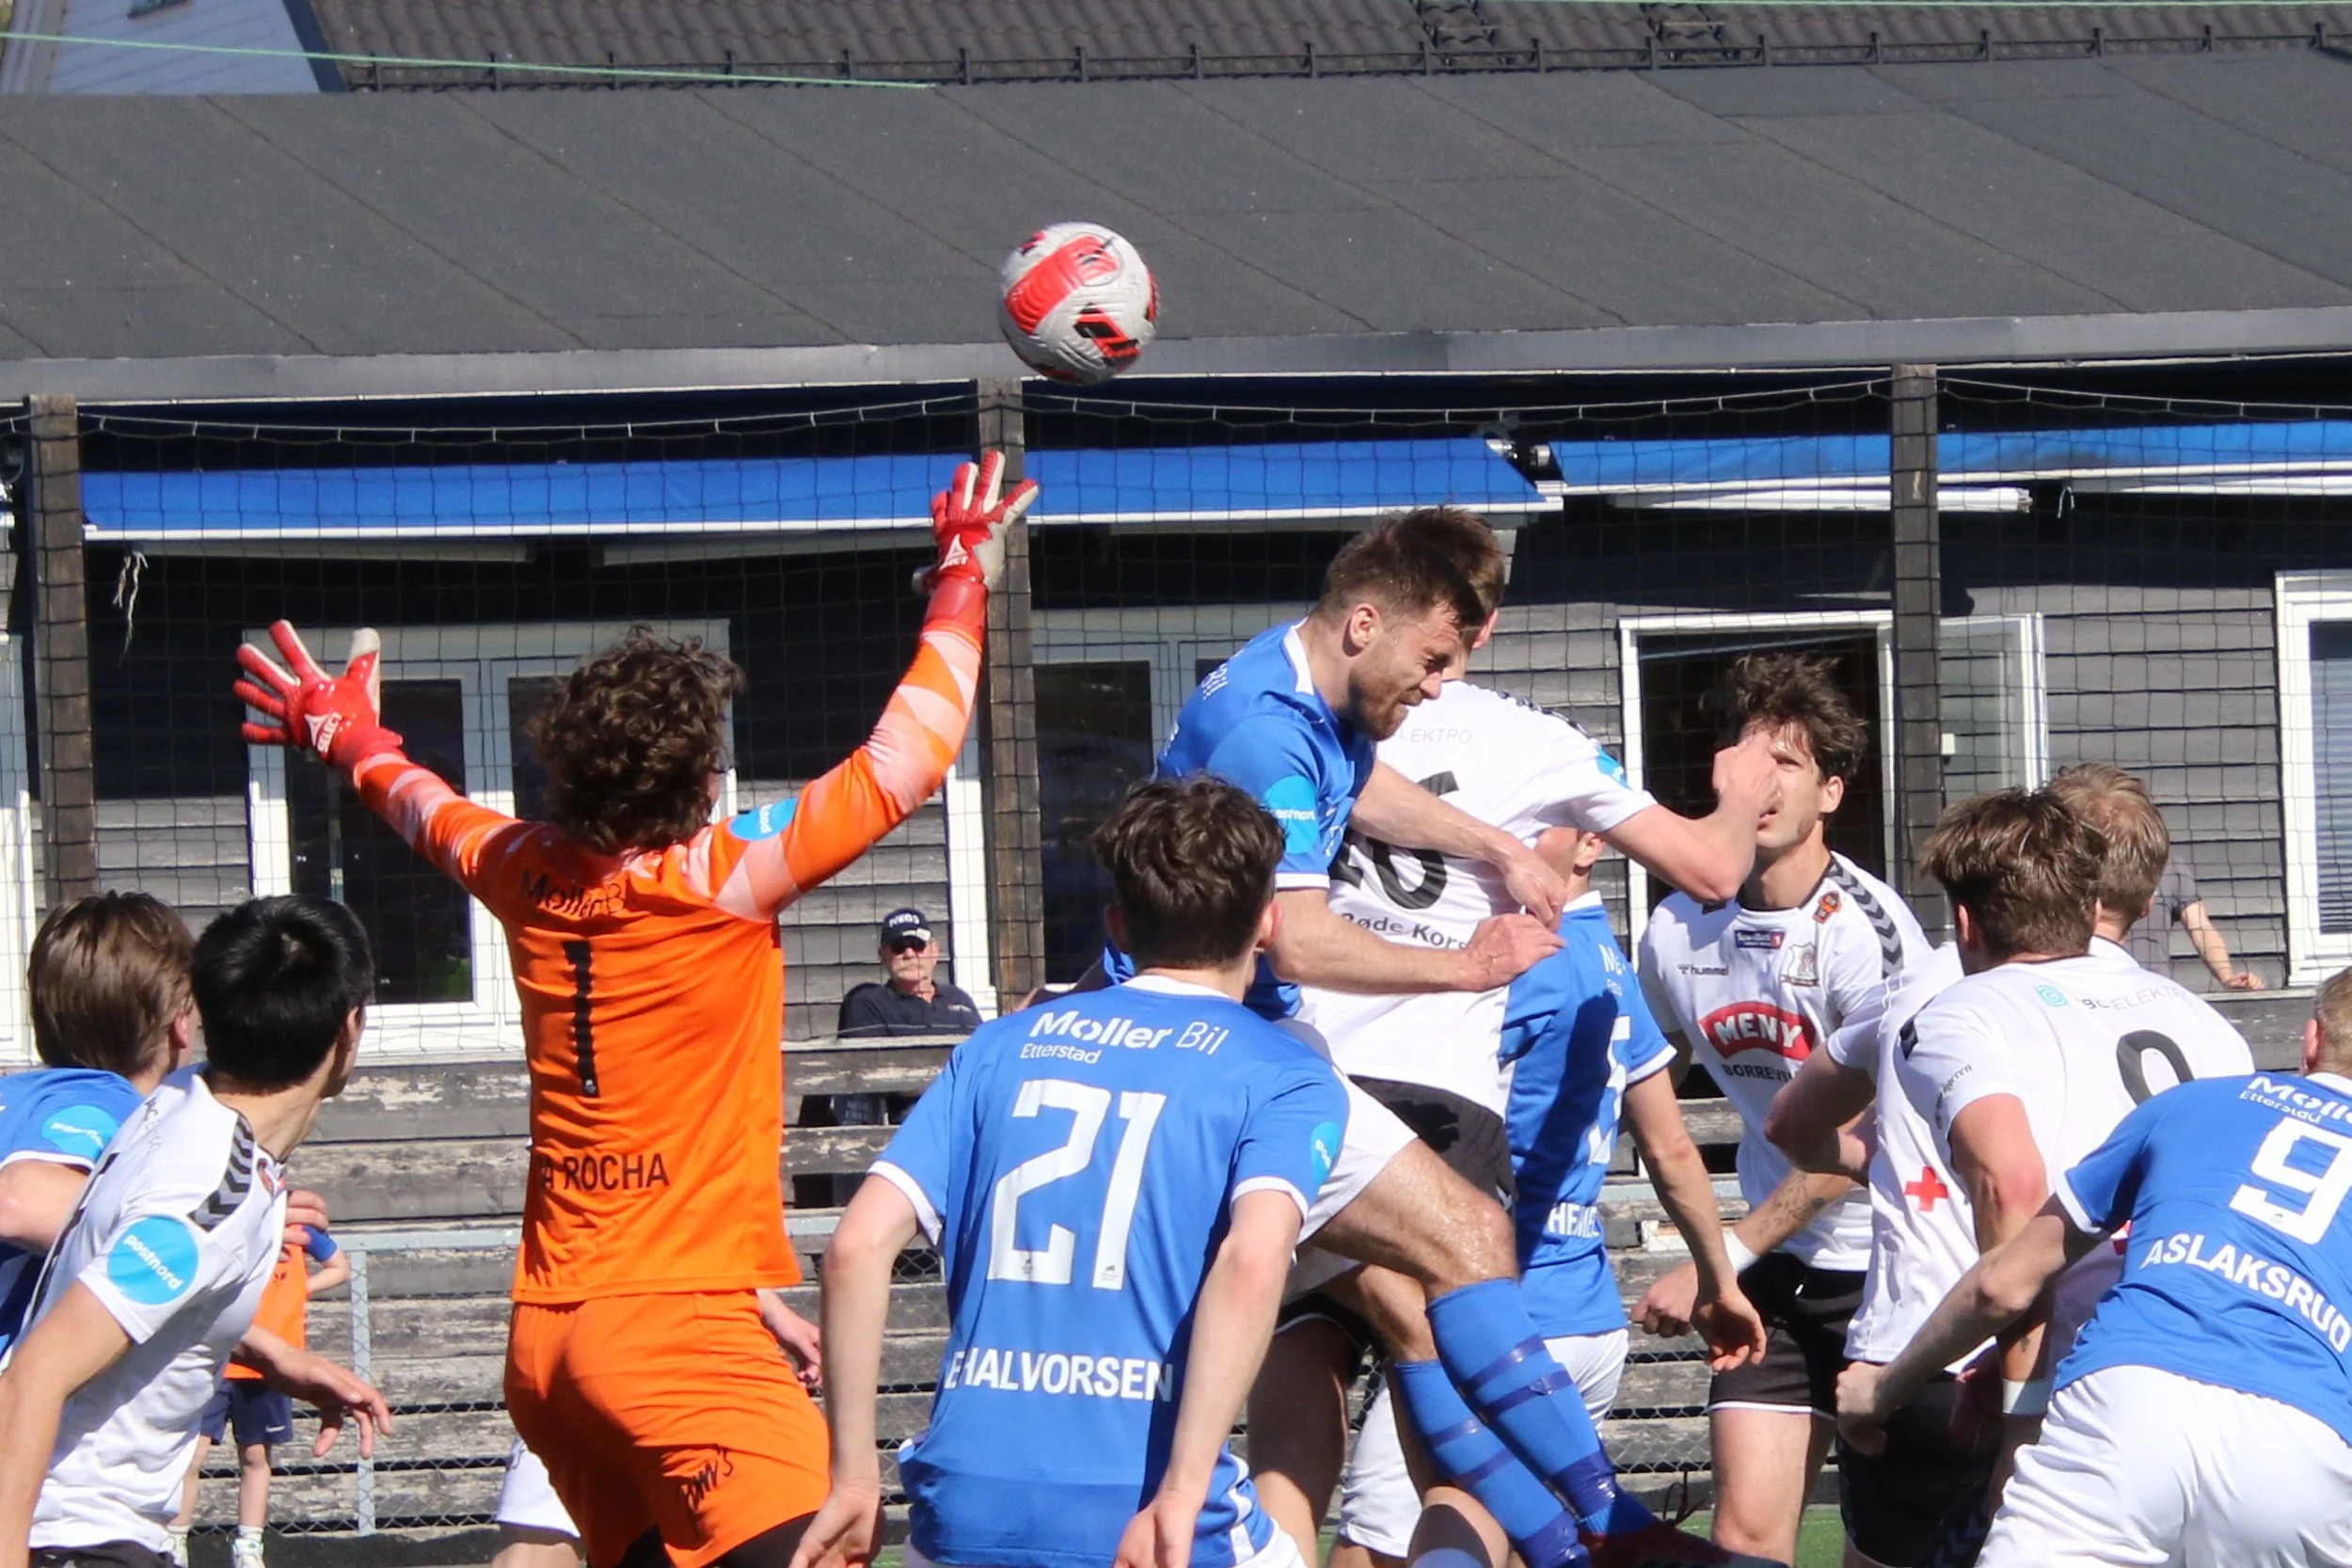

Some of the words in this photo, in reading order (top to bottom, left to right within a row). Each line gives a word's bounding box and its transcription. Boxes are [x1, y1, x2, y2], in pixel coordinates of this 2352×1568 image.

[1691, 964, 1729, 976] hummel
[562, 939, 599, 1099] 1
[1713, 1012, 1793, 1049] MENY
[1019, 1042, 1103, 1065] Etterstad
[1175, 1022, 1230, 1056] Bil
[564, 1152, 671, 1191] ROCHA
[987, 1078, 1167, 1291] 21
[2227, 1116, 2352, 1245] 9
[122, 1233, 184, 1291] postnord
